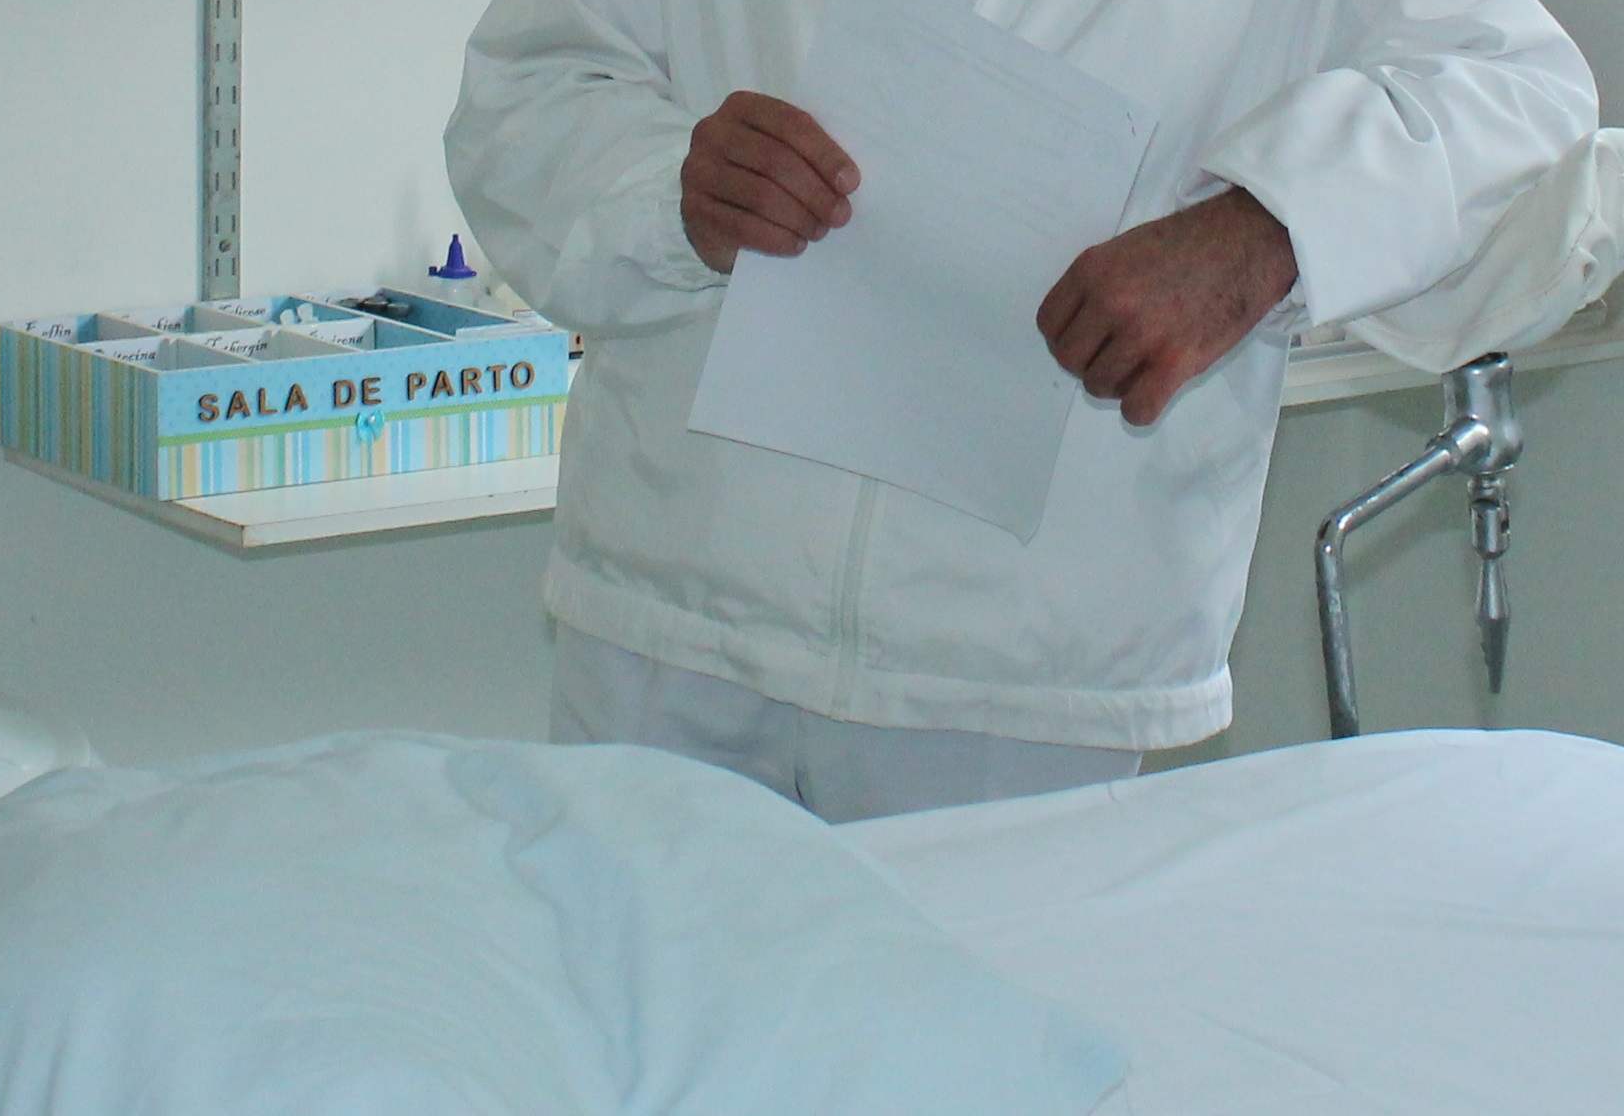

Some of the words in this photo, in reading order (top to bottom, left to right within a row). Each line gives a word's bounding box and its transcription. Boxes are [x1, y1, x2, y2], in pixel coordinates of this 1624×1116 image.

[198, 384, 310, 423] SALA
[333, 377, 383, 410] DE
[406, 361, 536, 401] PARTO
